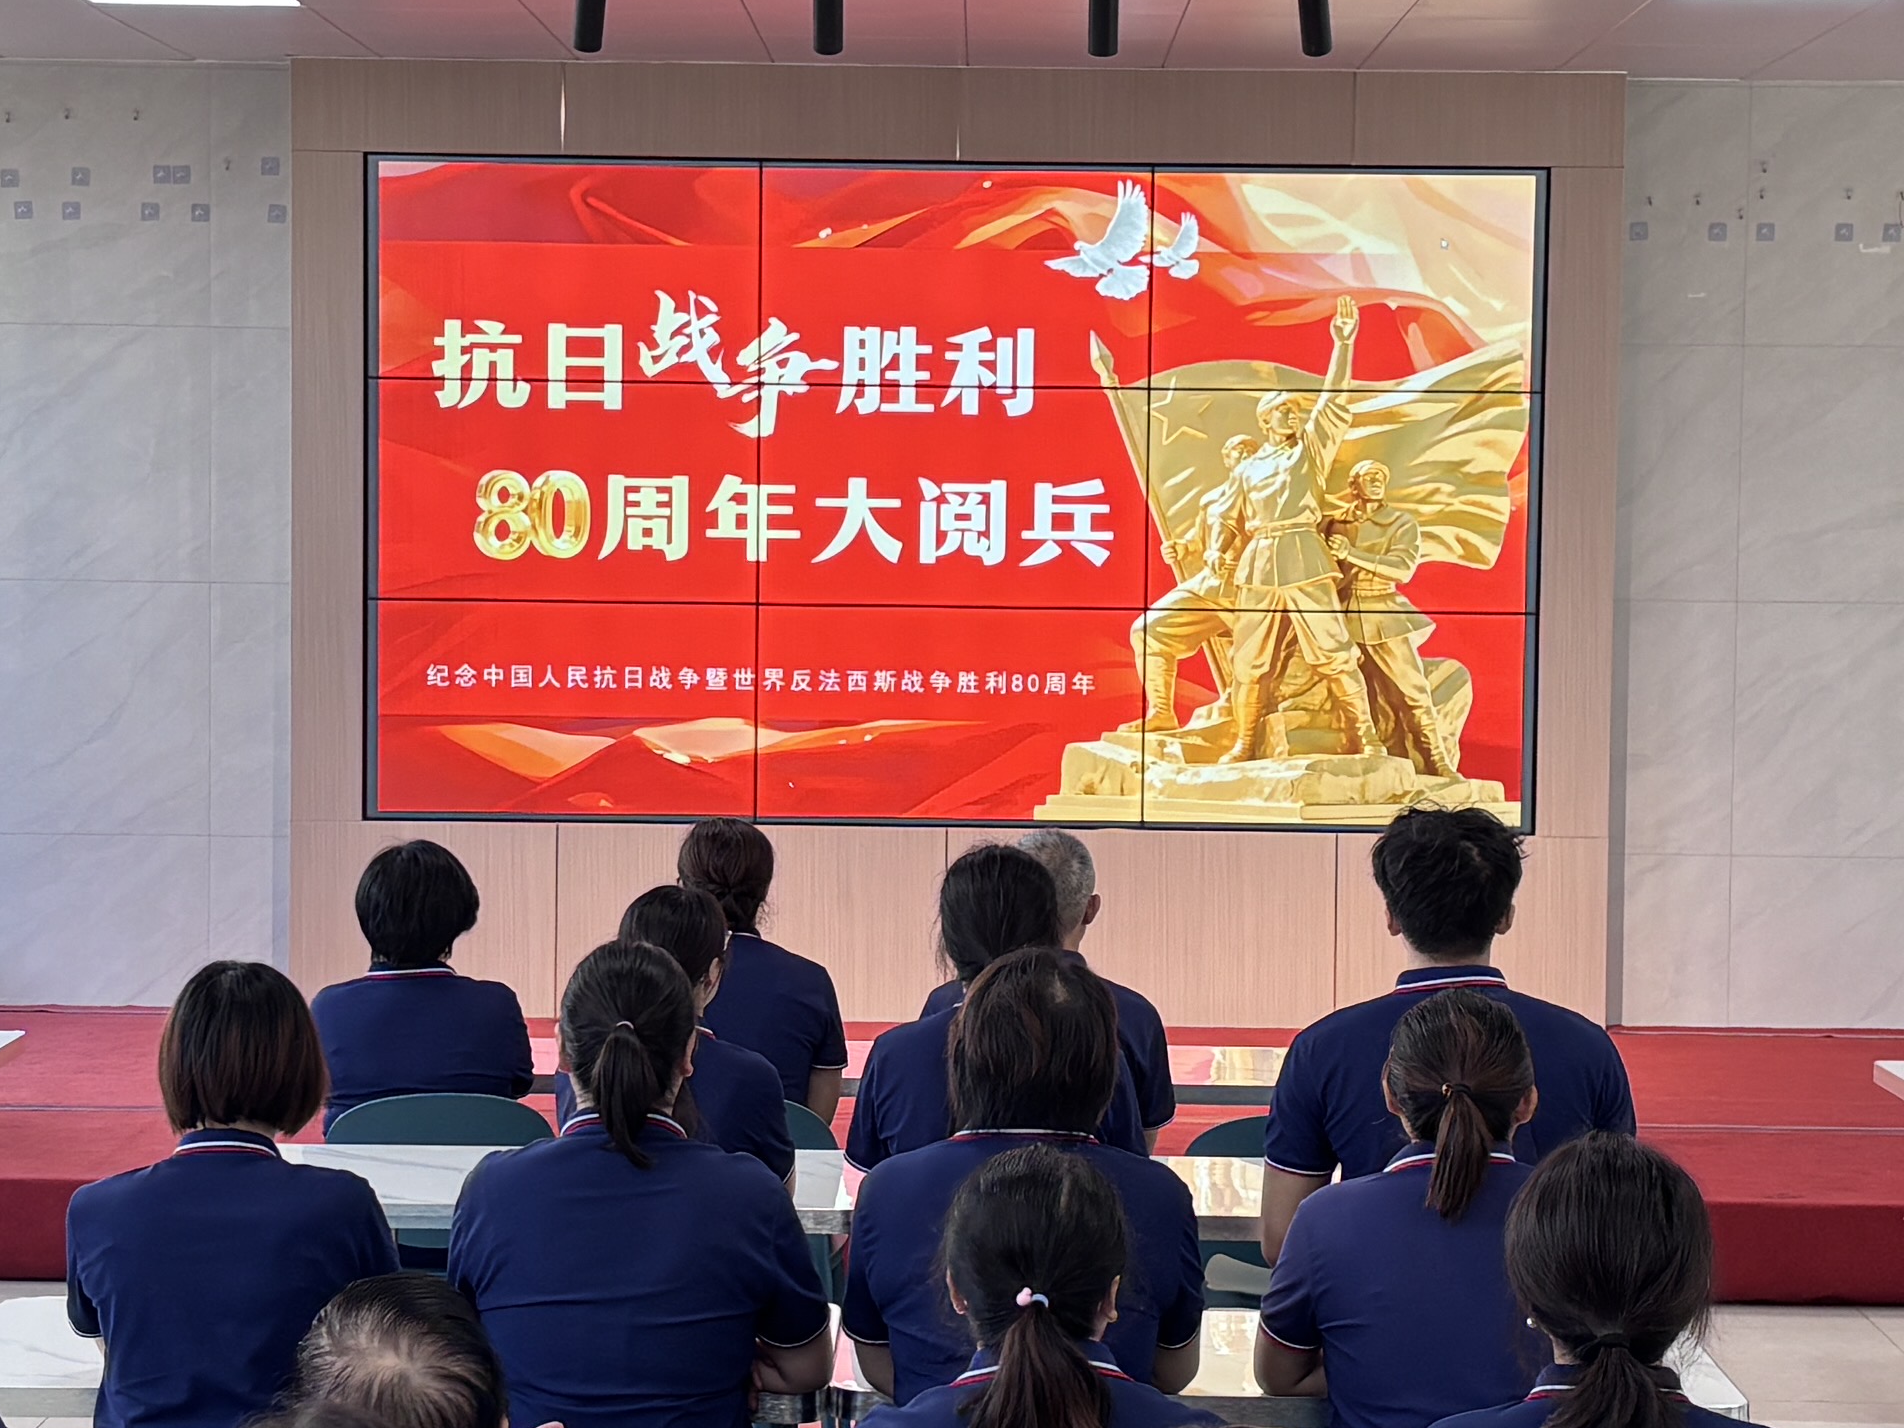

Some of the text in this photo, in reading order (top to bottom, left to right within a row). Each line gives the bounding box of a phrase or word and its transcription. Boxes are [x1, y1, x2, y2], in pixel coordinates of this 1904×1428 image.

[432, 289, 1037, 437] 抗日战争胜利
[473, 469, 1115, 567] 80周年大阅兵
[426, 662, 1097, 697] 纪念中国人民抗日战争暨世界反法西斯战争胜利80周年
